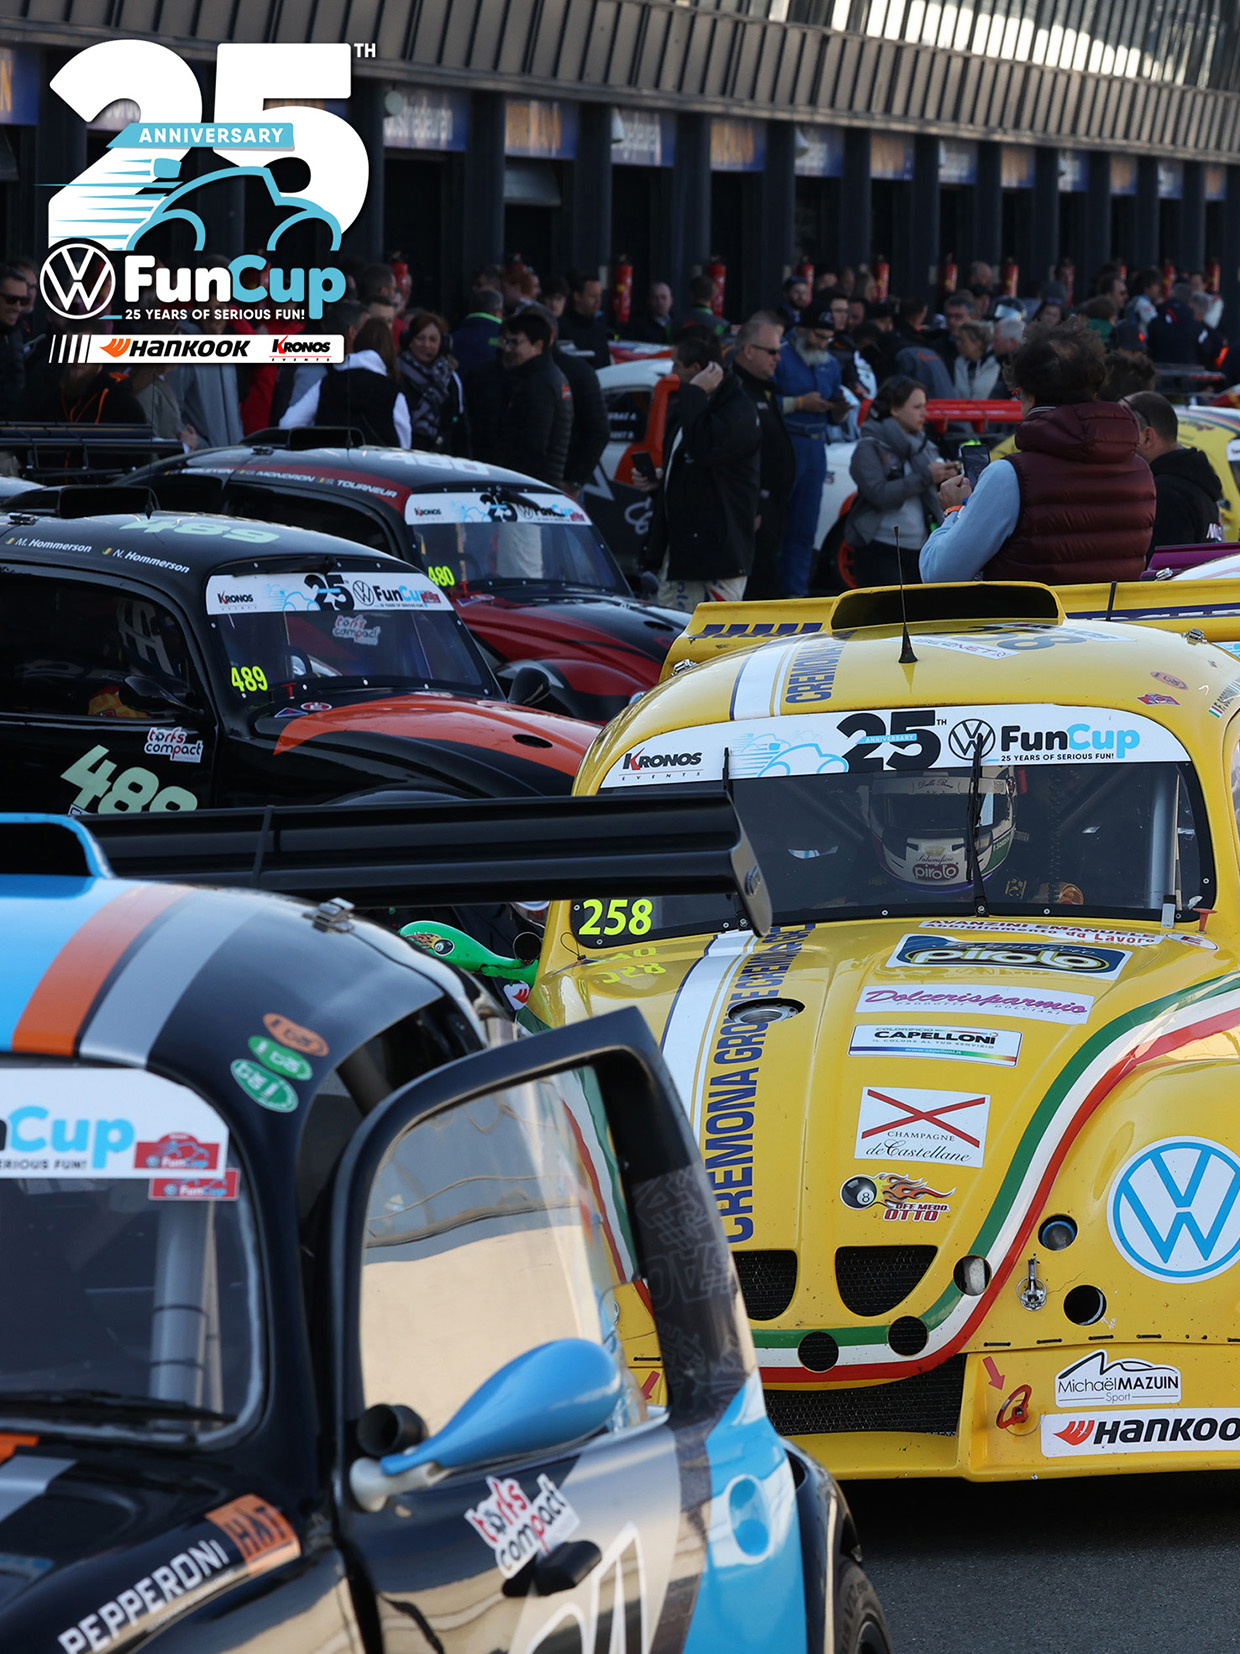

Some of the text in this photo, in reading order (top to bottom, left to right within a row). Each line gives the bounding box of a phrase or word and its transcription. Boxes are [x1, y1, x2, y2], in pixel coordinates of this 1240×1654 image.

[336, 479, 398, 499] TOURNEUR
[119, 519, 280, 544] 489
[14, 538, 92, 553] M. Hommerson
[112, 549, 191, 574] N. Hommerson
[428, 565, 456, 587] 480
[217, 590, 254, 604] KRONOS
[231, 666, 268, 693] 489
[148, 728, 185, 744] torfs
[837, 710, 948, 773] 25 TH
[1001, 723, 1140, 759] FunCup
[145, 741, 202, 760] compact
[623, 748, 703, 770] KRONOS
[1057, 753, 1093, 761] SERIOUS
[578, 899, 653, 936] 258
[928, 920, 1157, 938] AVANZINI EMANUELE
[1094, 934, 1155, 944] Lavoro
[865, 990, 1088, 1014] Dolcerisparmio
[714, 989, 779, 1066] GROE
[874, 1031, 996, 1045] CAPELLONI
[887, 1131, 955, 1142] CHAMPAGNE
[705, 1067, 759, 1244] CREMONA
[884, 1209, 940, 1222] OTTO
[1105, 1392, 1132, 1404] Sport
[498, 1489, 568, 1572] compact
[57, 1539, 230, 1654] PEPPERONI
